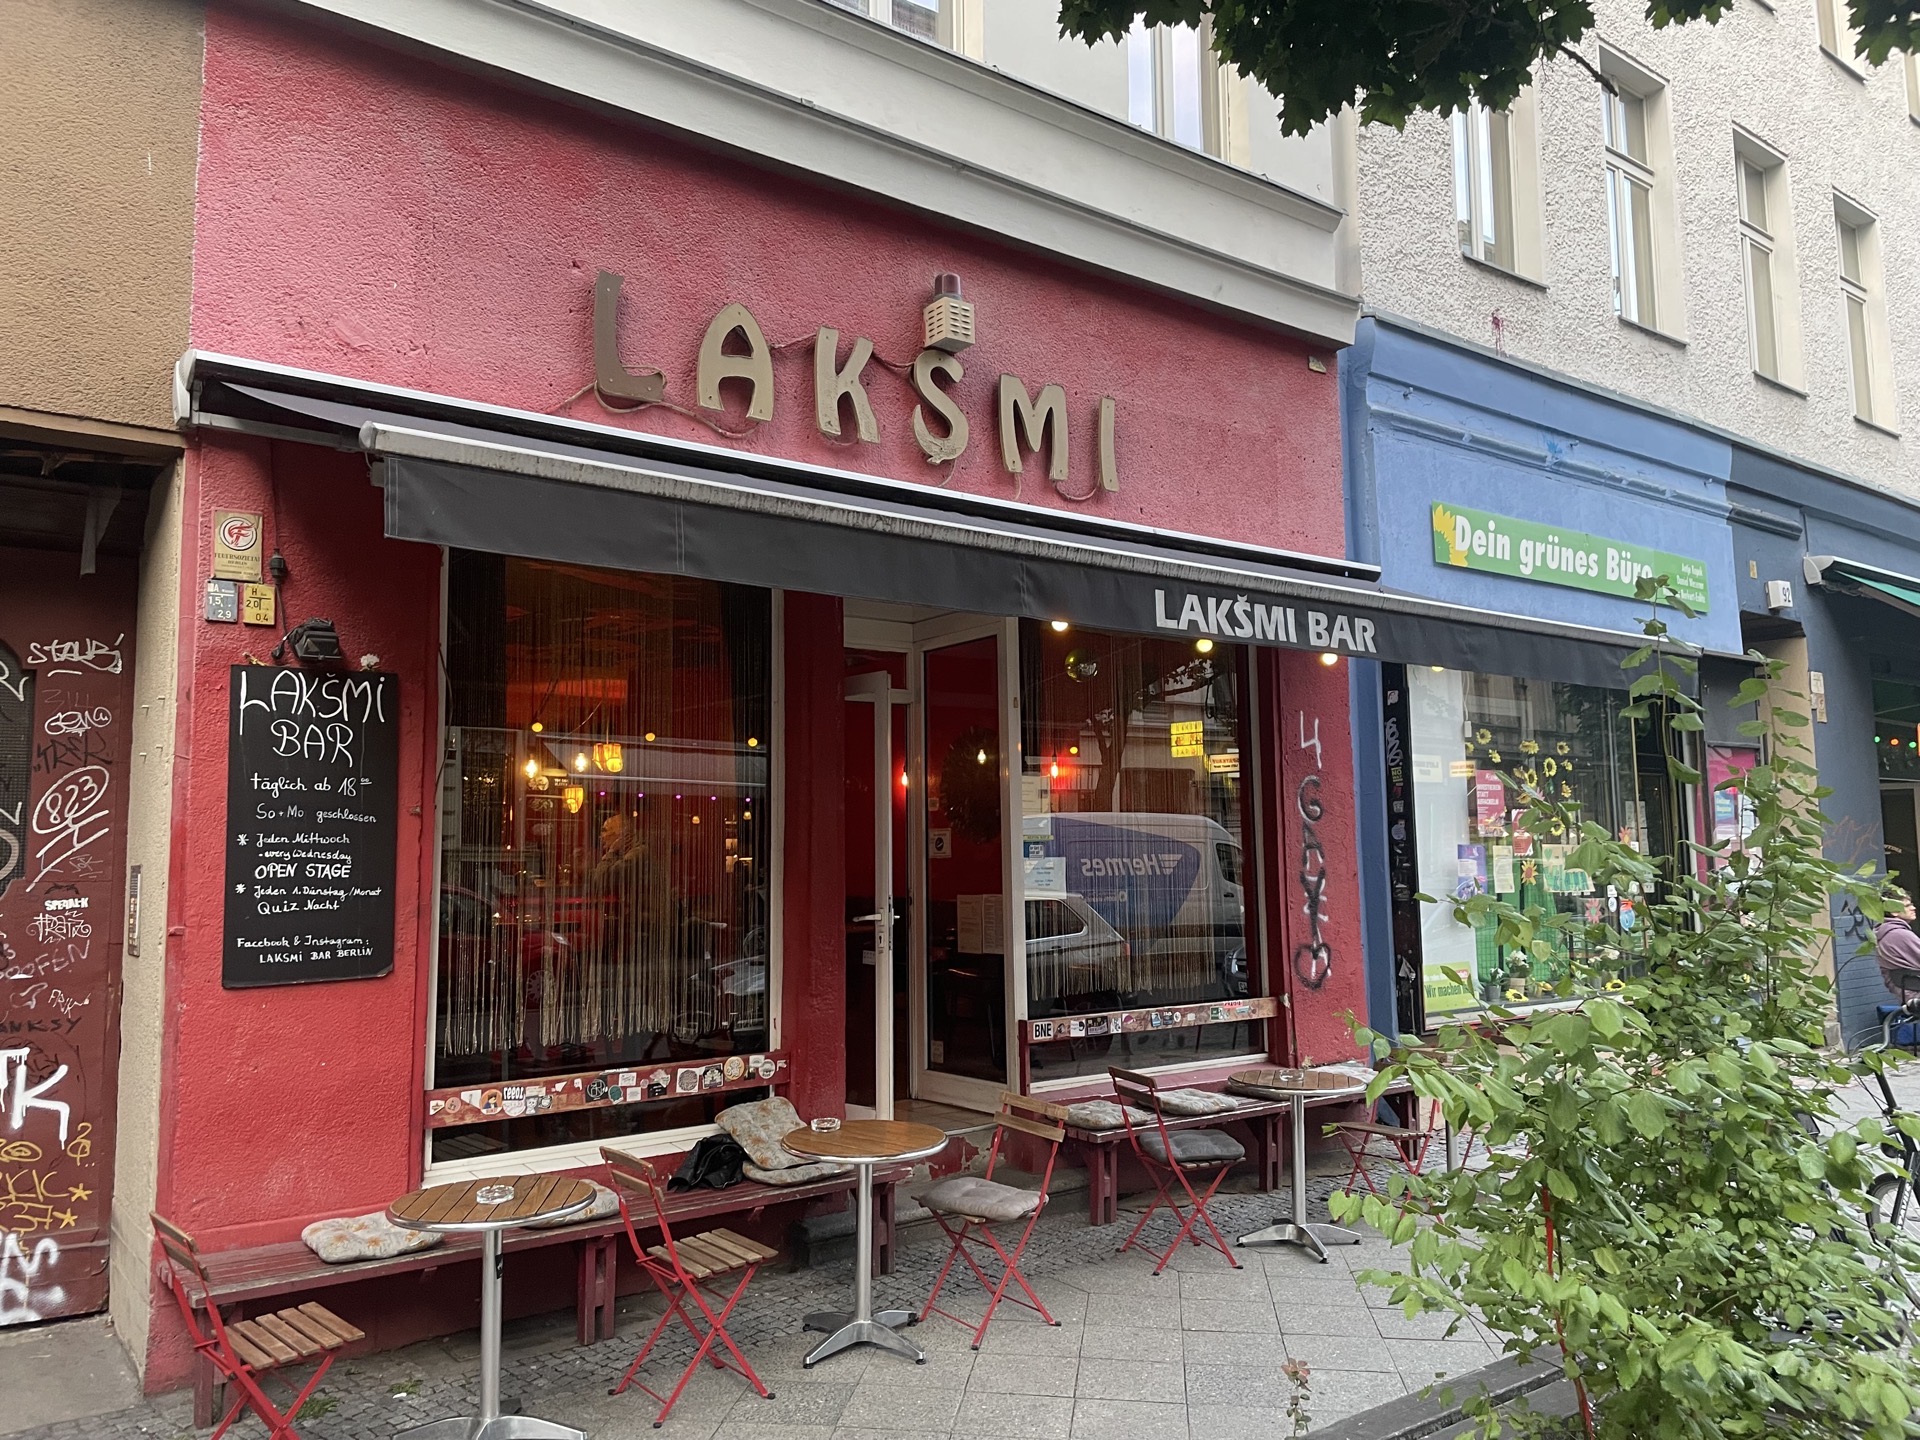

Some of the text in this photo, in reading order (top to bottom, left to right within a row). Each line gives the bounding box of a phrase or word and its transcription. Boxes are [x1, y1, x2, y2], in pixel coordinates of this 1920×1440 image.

[1455, 514, 1511, 561] Dein
[1519, 534, 1599, 576] grünes
[1782, 586, 1791, 603] 92
[217, 609, 232, 620] 2,9
[1155, 589, 1377, 653] LAKŠMI BAR
[271, 718, 353, 768] BAR
[250, 771, 307, 798] täglich
[314, 777, 331, 791] ab
[316, 808, 377, 824] geschlossen
[292, 832, 350, 844] Mittwoch
[292, 849, 352, 864] Wednesday
[254, 862, 351, 880] OPEN STAGE
[257, 899, 340, 915] Quiz Nacht
[237, 937, 290, 948] Facebook
[293, 936, 301, 946] &
[310, 950, 331, 961] BAR
[1034, 1022, 1052, 1038] BNE
